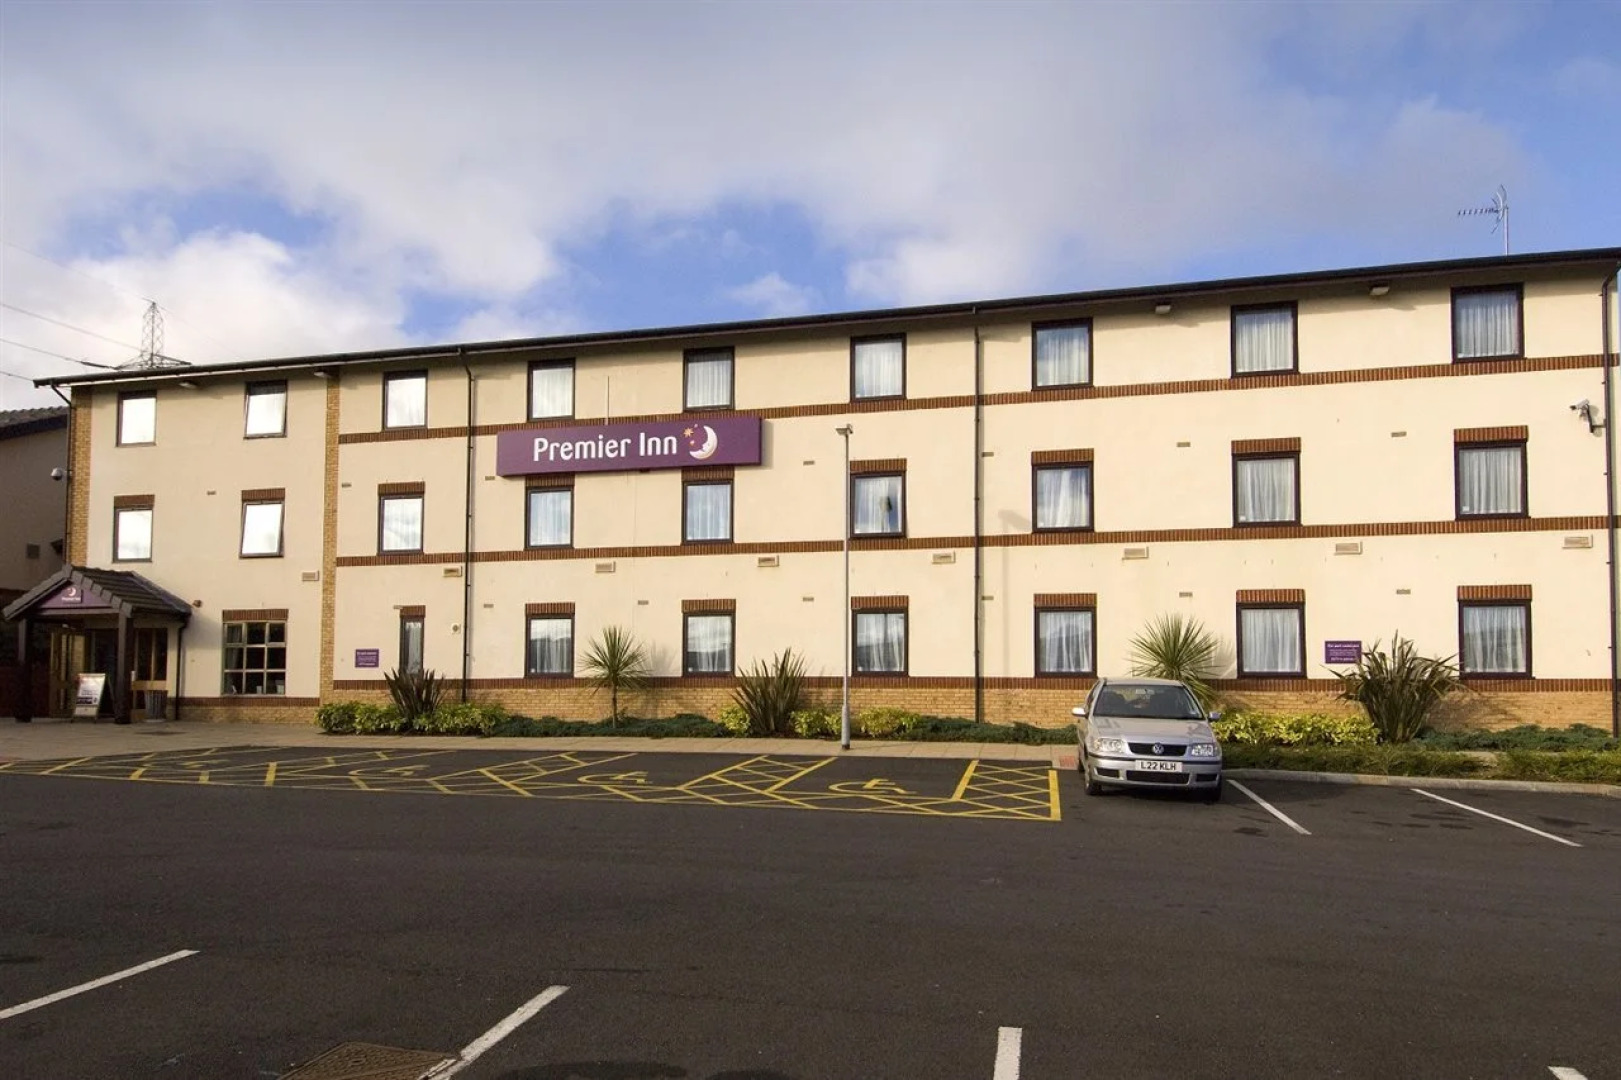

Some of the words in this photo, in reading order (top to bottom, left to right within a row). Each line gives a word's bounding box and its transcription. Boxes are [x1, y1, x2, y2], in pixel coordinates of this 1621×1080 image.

[533, 434, 631, 462] Premier
[639, 432, 678, 457] Inn
[1140, 761, 1158, 771] L22
[1159, 761, 1177, 771] KLH
